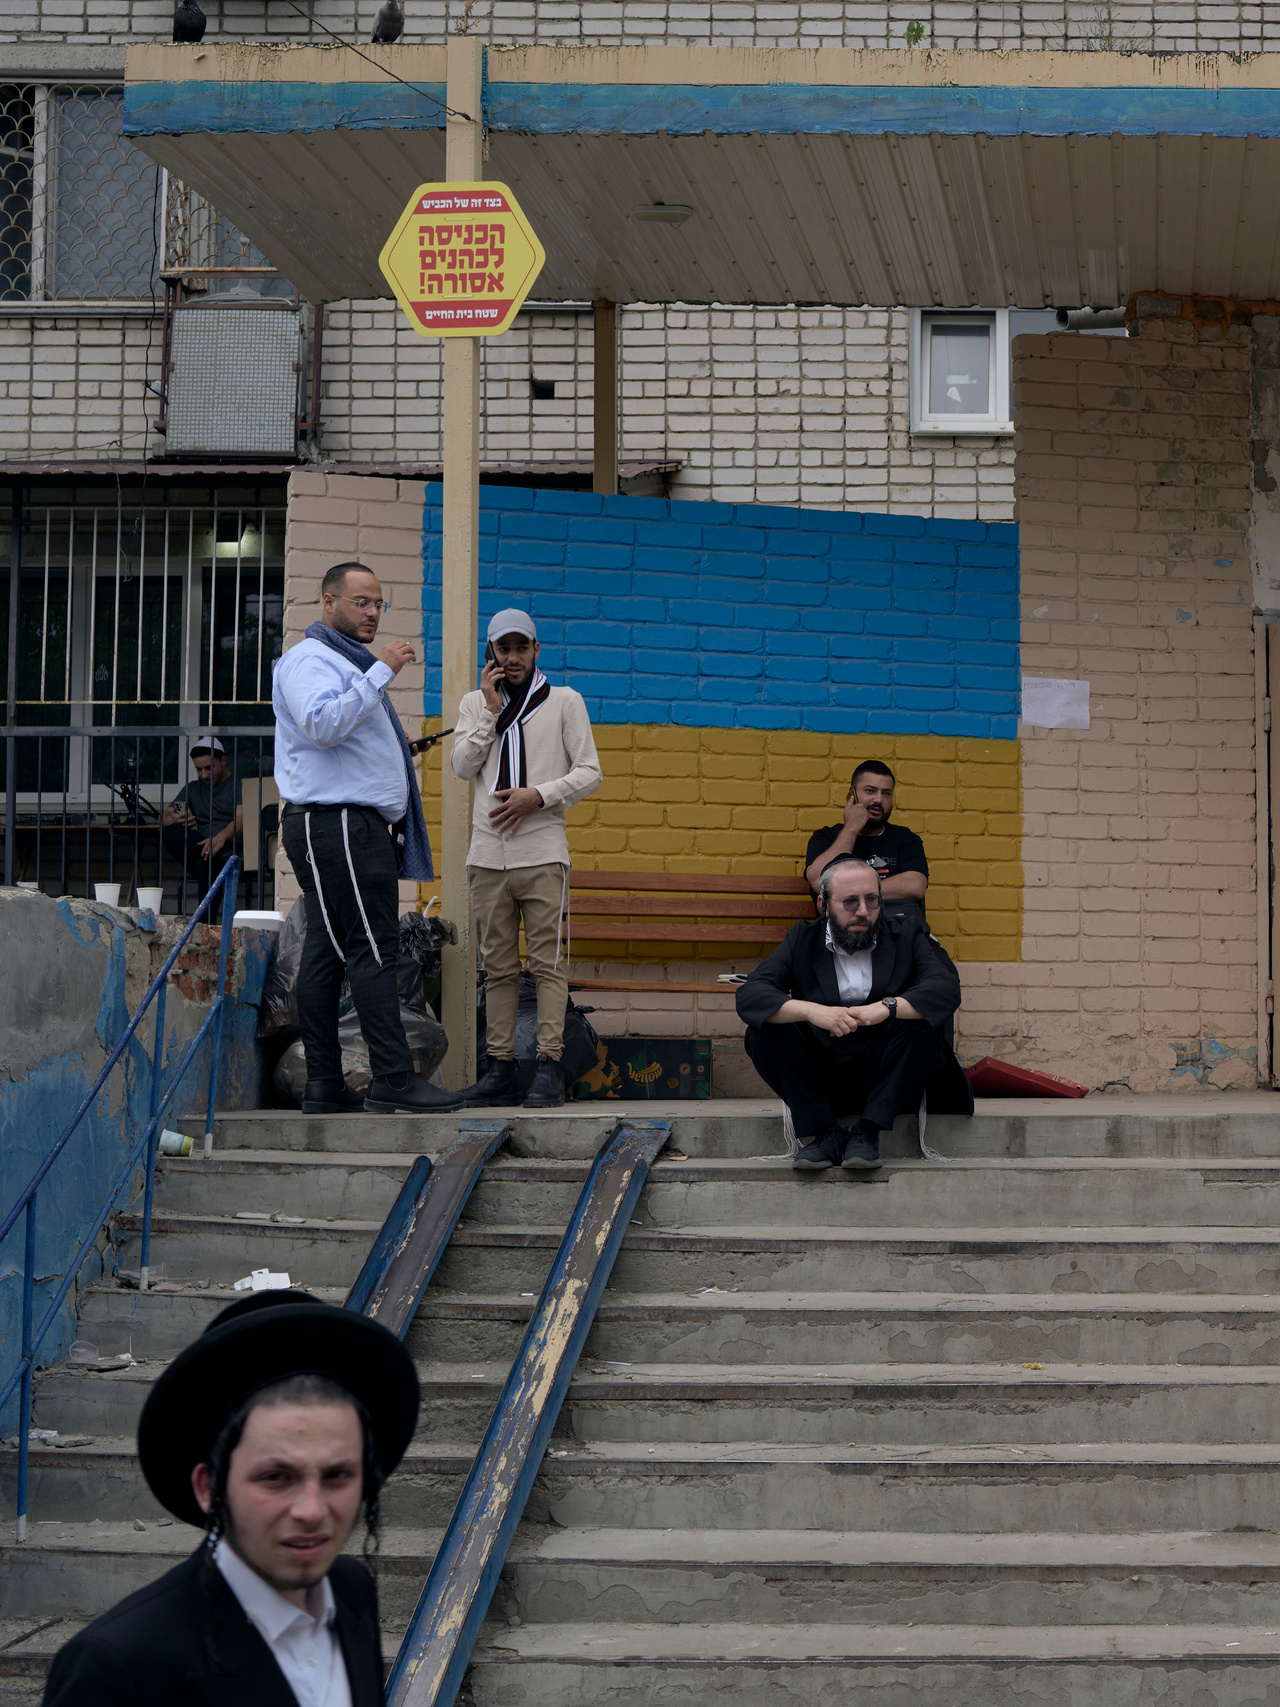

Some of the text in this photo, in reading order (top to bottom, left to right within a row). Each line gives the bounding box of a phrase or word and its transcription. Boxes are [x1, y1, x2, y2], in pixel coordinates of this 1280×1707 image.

[422, 197, 502, 209] בצד זה של הכביש
[418, 223, 506, 246] הכניסה
[418, 242, 505, 270] לכהנים
[419, 271, 505, 295] אסורה!
[425, 308, 499, 320] שטח בית החיים
[626, 1061, 664, 1084] yellow
